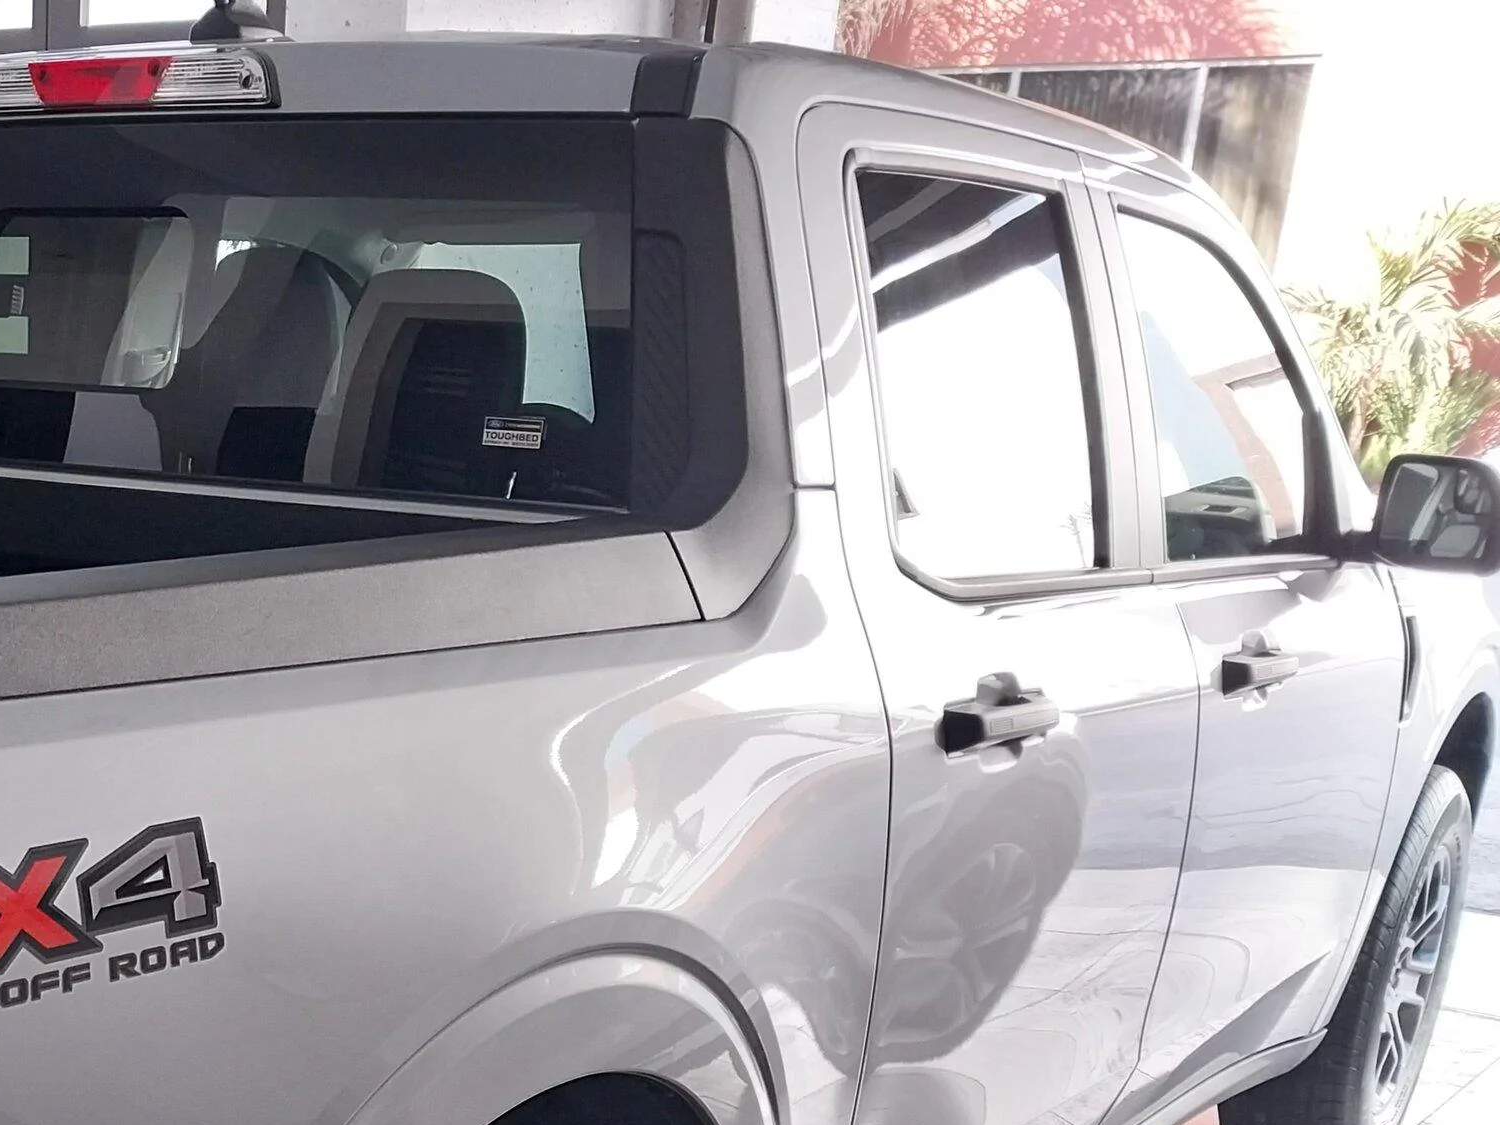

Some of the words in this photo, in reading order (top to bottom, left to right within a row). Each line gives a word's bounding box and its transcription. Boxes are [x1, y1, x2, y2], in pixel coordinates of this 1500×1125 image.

[485, 430, 539, 442] TOUGHBED
[0, 963, 91, 1008] OFF
[108, 932, 225, 982] ROAD
